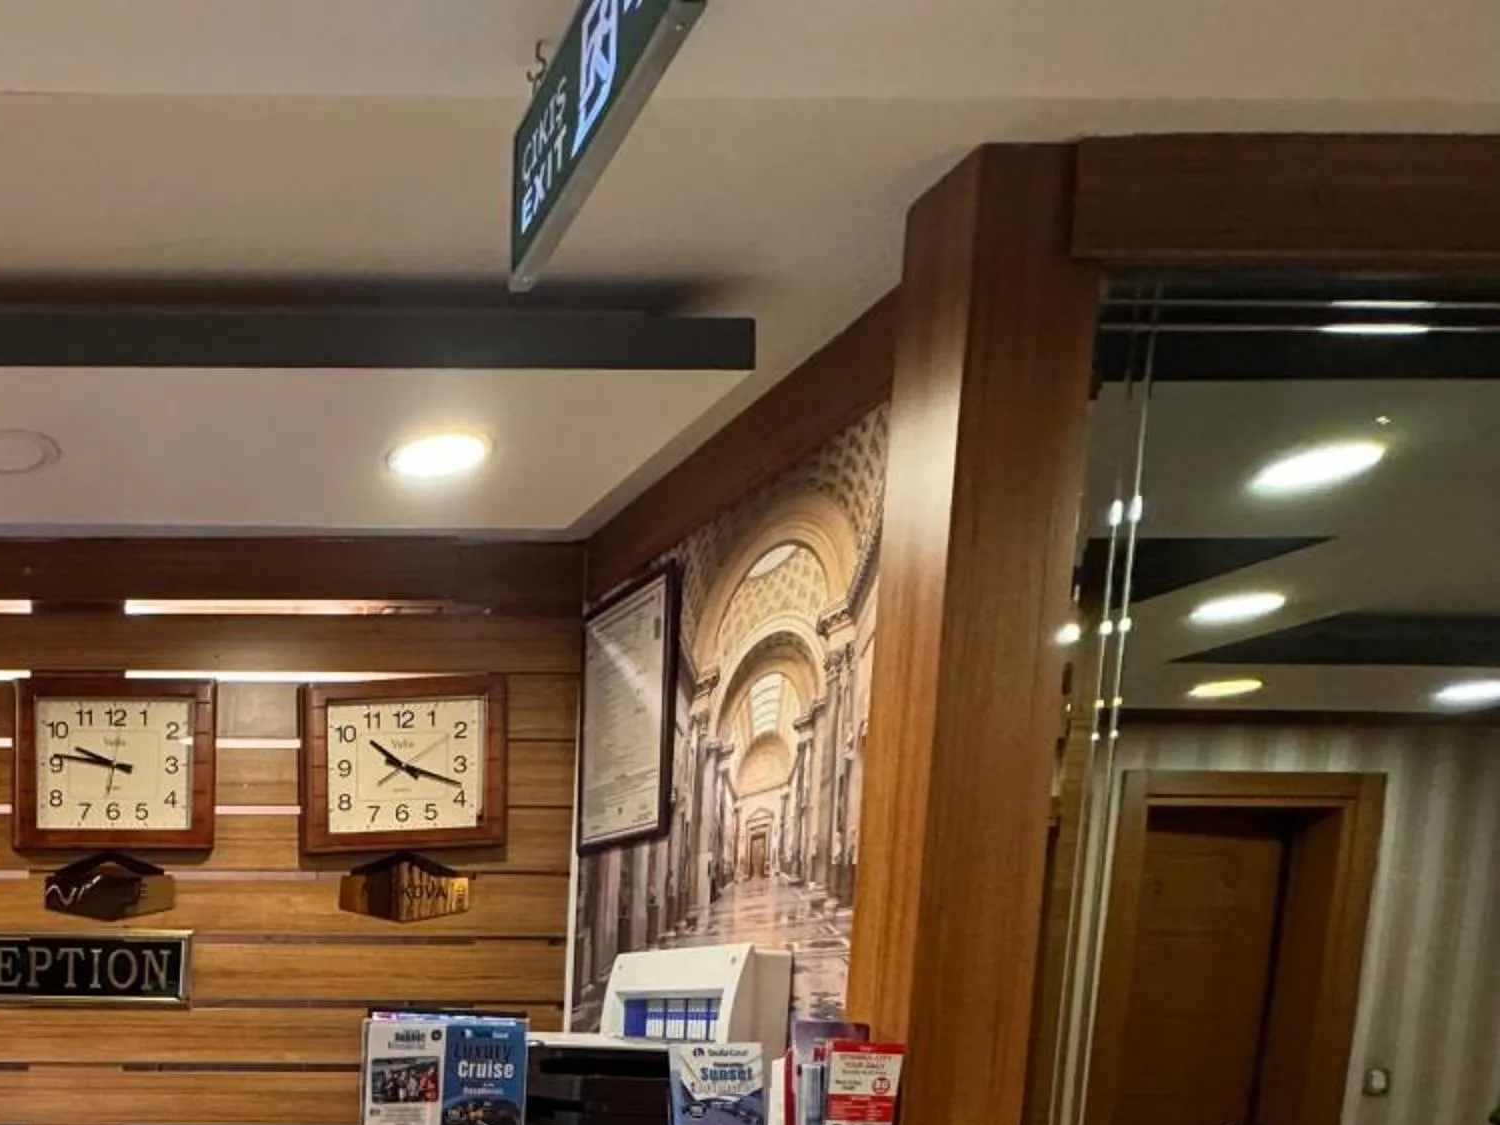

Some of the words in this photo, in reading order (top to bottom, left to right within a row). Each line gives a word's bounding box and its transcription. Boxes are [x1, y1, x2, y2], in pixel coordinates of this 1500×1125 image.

[521, 124, 567, 234] EXIT
[75, 710, 93, 726] 11
[104, 710, 127, 727] 12
[139, 710, 148, 726] 1
[363, 712, 381, 728] 11
[393, 710, 415, 728] 12
[427, 710, 436, 727] 1
[46, 721, 69, 739] 10
[334, 725, 357, 743] 10
[453, 722, 467, 738] 2
[165, 757, 179, 774] 3
[337, 760, 352, 777] 9
[453, 755, 467, 773] 3
[49, 790, 63, 807] 8
[164, 791, 177, 808] 4
[337, 793, 352, 811] 8
[453, 790, 466, 807] 4
[78, 803, 92, 821] 7
[106, 804, 120, 821] 6
[135, 803, 149, 821] 5
[367, 805, 380, 823] 7
[396, 804, 409, 822] 6
[424, 804, 438, 821] 5
[458, 1060, 515, 1079] Cruise
